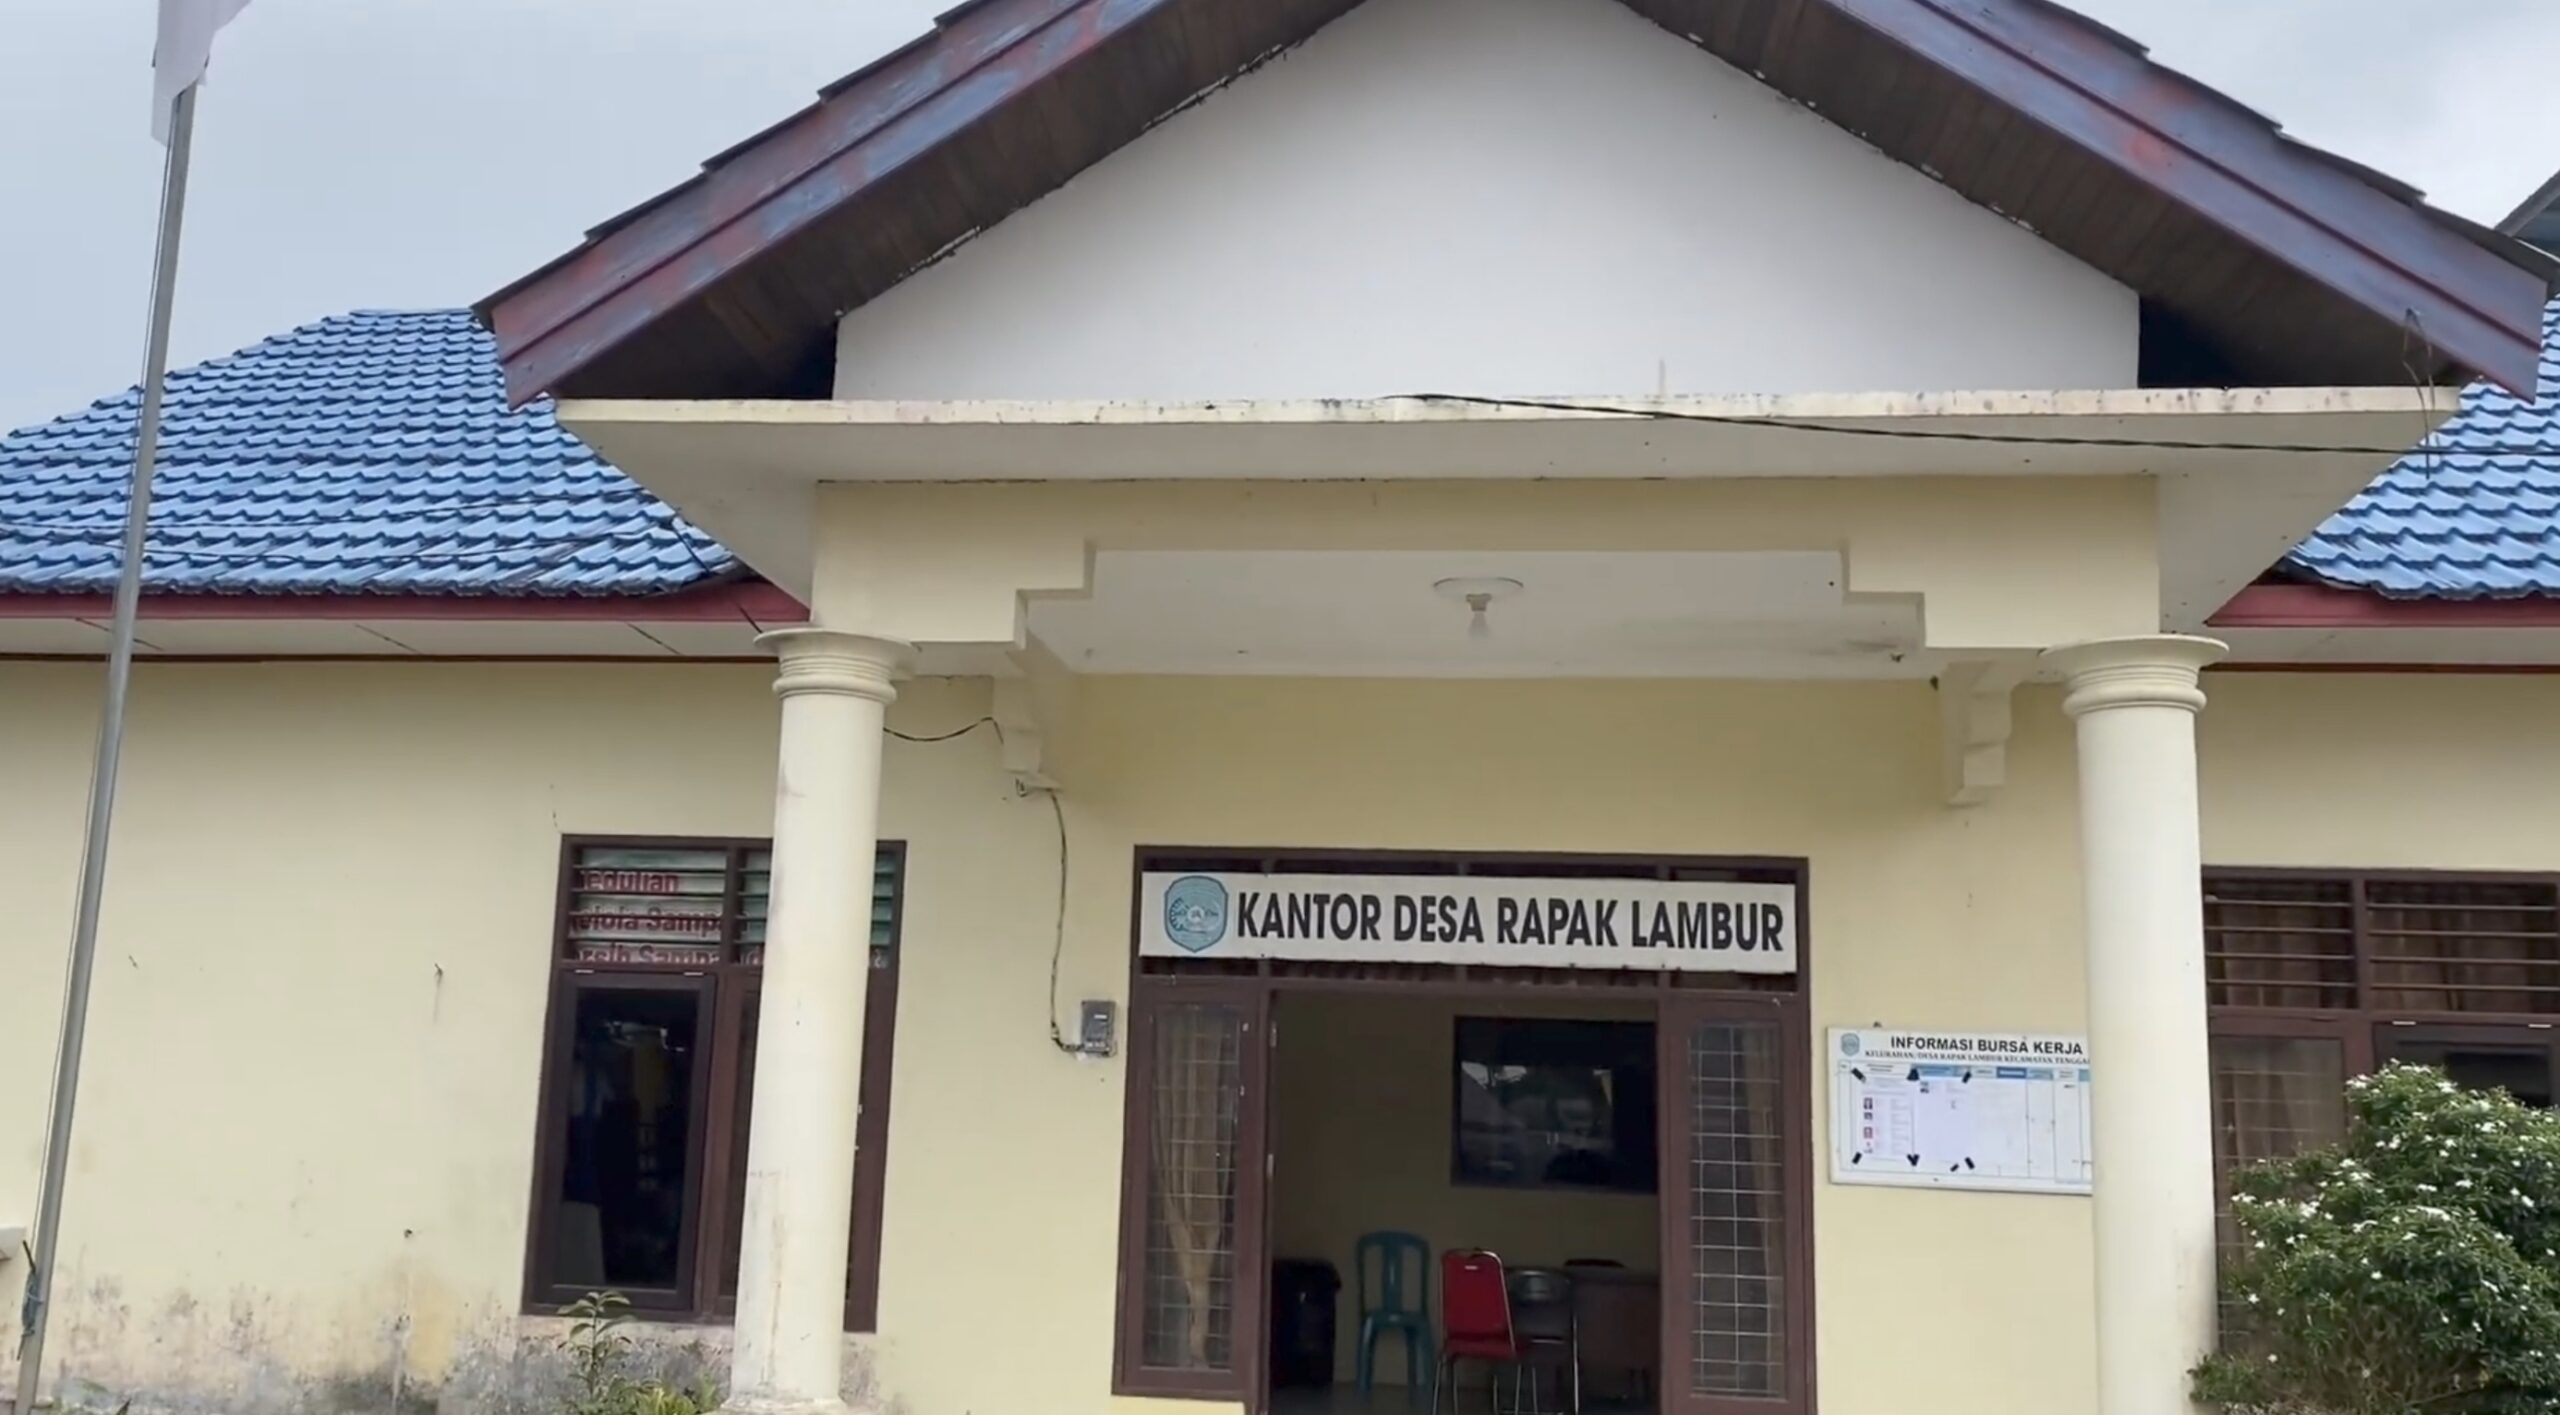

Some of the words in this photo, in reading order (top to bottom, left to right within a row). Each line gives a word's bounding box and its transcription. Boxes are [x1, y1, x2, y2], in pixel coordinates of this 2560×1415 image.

[1237, 892, 1381, 941] KANTOR
[1394, 895, 1485, 943] DESA
[1497, 897, 1619, 947] RAPAK
[1631, 900, 1784, 951] LAMBUR
[1890, 1036, 1973, 1051] INFORMASI
[1978, 1039, 2029, 1053] BURSA
[2033, 1041, 2083, 1055] KERJA
